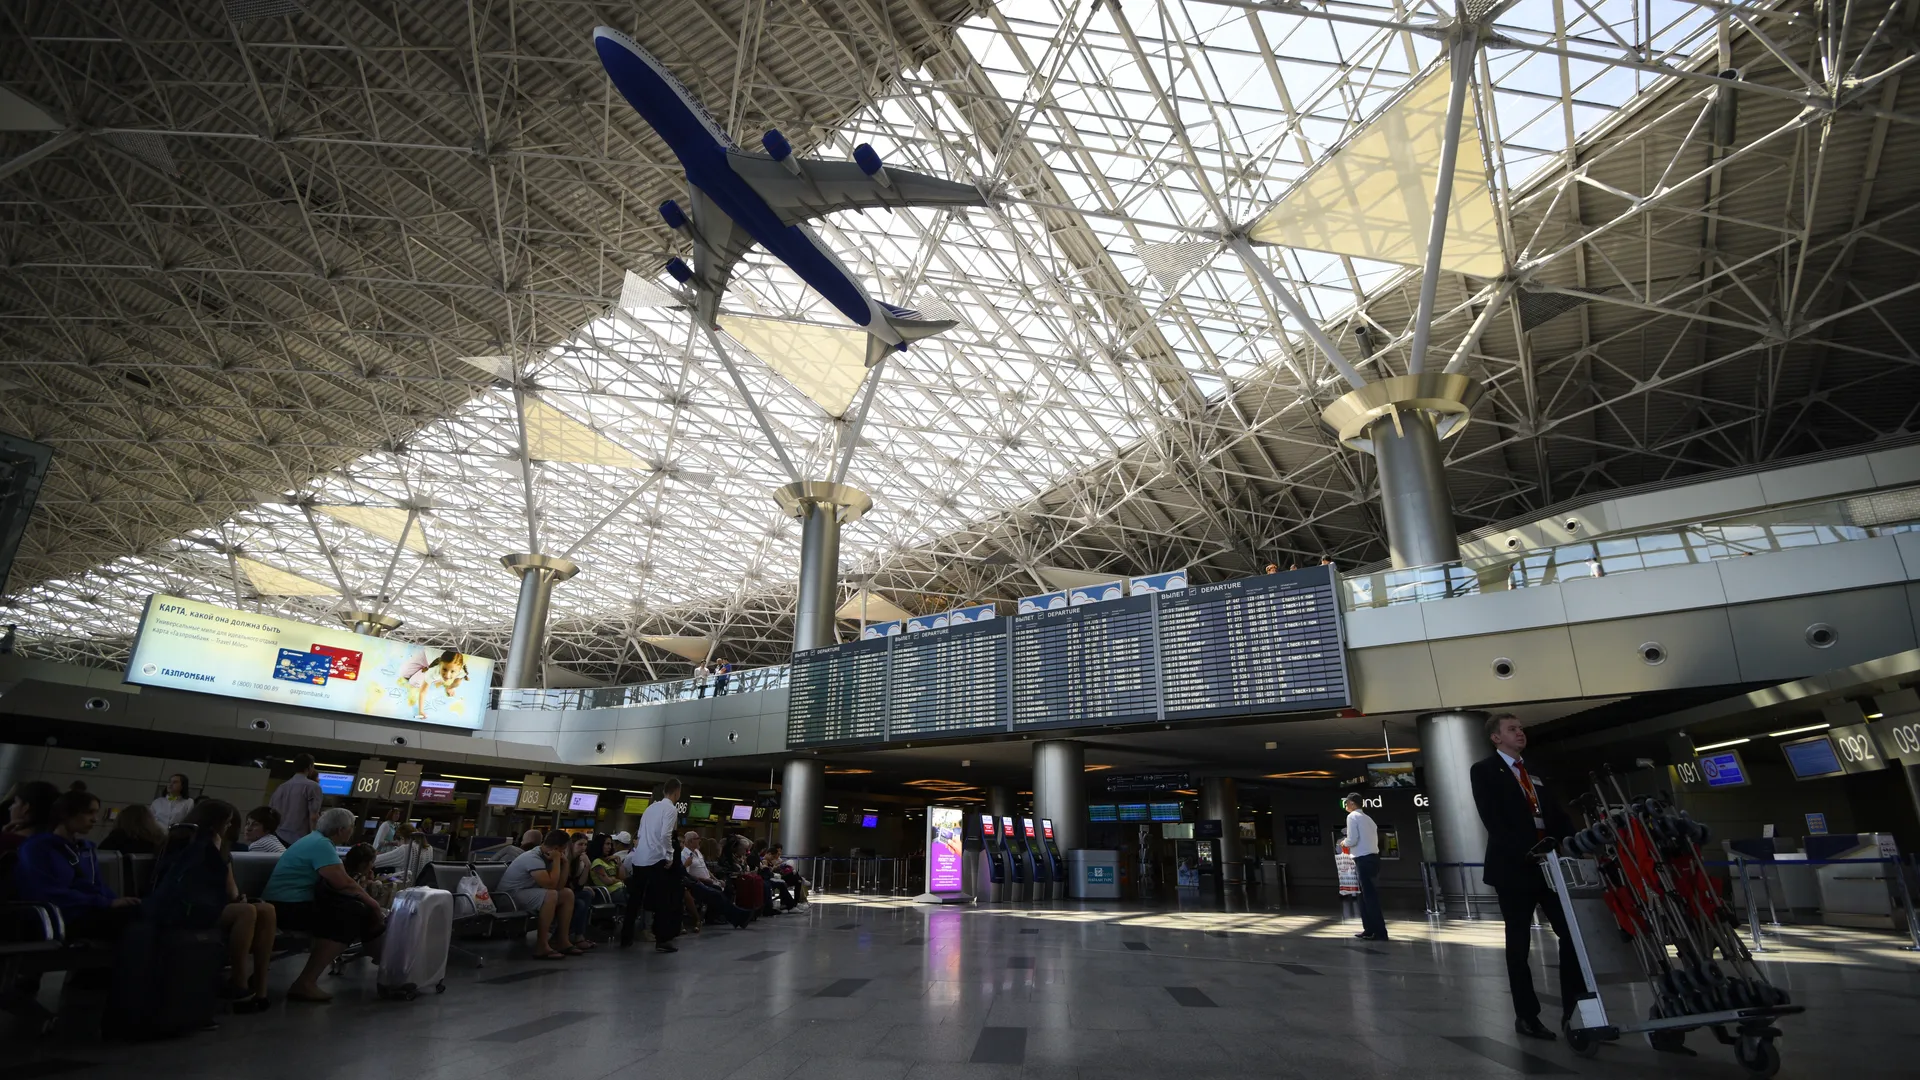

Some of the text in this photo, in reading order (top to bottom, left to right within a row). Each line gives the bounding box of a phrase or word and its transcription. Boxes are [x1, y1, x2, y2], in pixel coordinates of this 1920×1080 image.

[1162, 590, 1184, 599] ВЫЛЕТ
[1201, 582, 1242, 594] DEPARTURE
[159, 603, 188, 616] КАРТА,
[190, 611, 214, 621] какой
[230, 619, 260, 630] должна
[262, 624, 281, 634] быть
[1047, 607, 1080, 618] DEPARTURE
[921, 628, 949, 638] DEPARTURE
[161, 668, 216, 683] ГАЗПРОМБАНК
[290, 688, 330, 699] gazprombank.ru
[1839, 734, 1875, 762] 092
[1677, 761, 1701, 784] 091
[358, 778, 380, 792] 081
[395, 780, 415, 795] 082
[523, 790, 539, 803] 083
[551, 792, 568, 806] 084
[754, 808, 765, 818] 087
